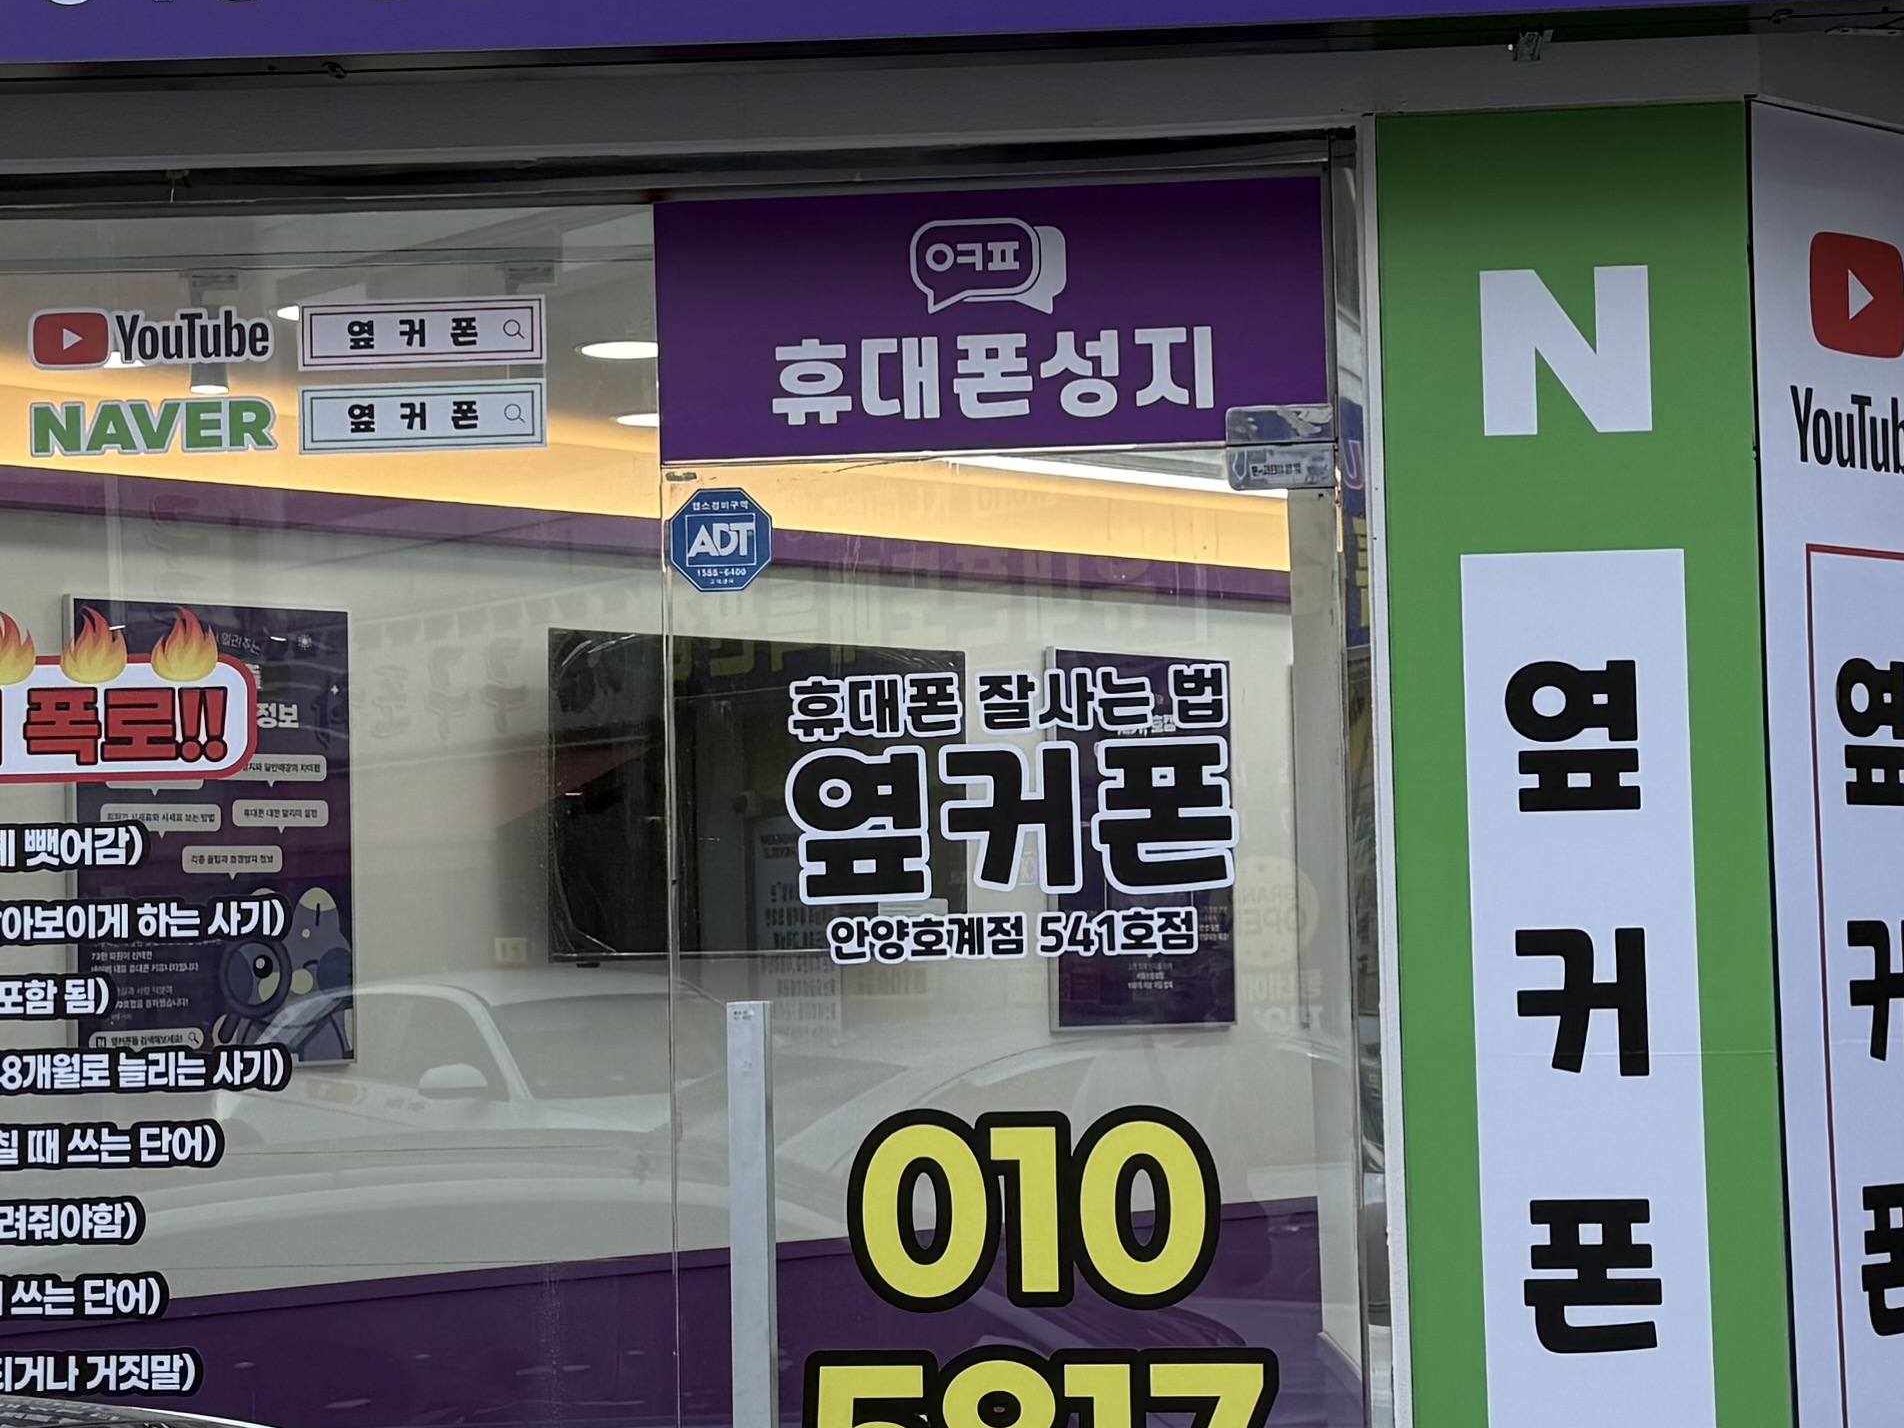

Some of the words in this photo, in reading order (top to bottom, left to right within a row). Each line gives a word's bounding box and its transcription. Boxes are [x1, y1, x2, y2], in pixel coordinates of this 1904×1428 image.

[116, 311, 270, 360] YouTube
[1479, 265, 1652, 437] N
[772, 325, 1214, 426] 휴대폰성지
[32, 401, 273, 454] NAVER
[688, 522, 755, 556] ADT
[23, 686, 228, 766] 폭로!!
[792, 675, 959, 738] 휴대폰
[980, 669, 1150, 730] 잘사는
[1172, 666, 1226, 727] 법
[23, 825, 143, 868] 뺏어감)
[790, 742, 1236, 899] 옆커폰
[138, 899, 202, 939] 하는
[209, 897, 285, 939] 사기)
[831, 914, 1023, 961] 안양호계점
[1039, 909, 1196, 954] 541호점
[64, 976, 110, 1018] 됨)
[1504, 660, 1663, 1354] 옆커폰
[863, 1121, 1206, 1297] 010
